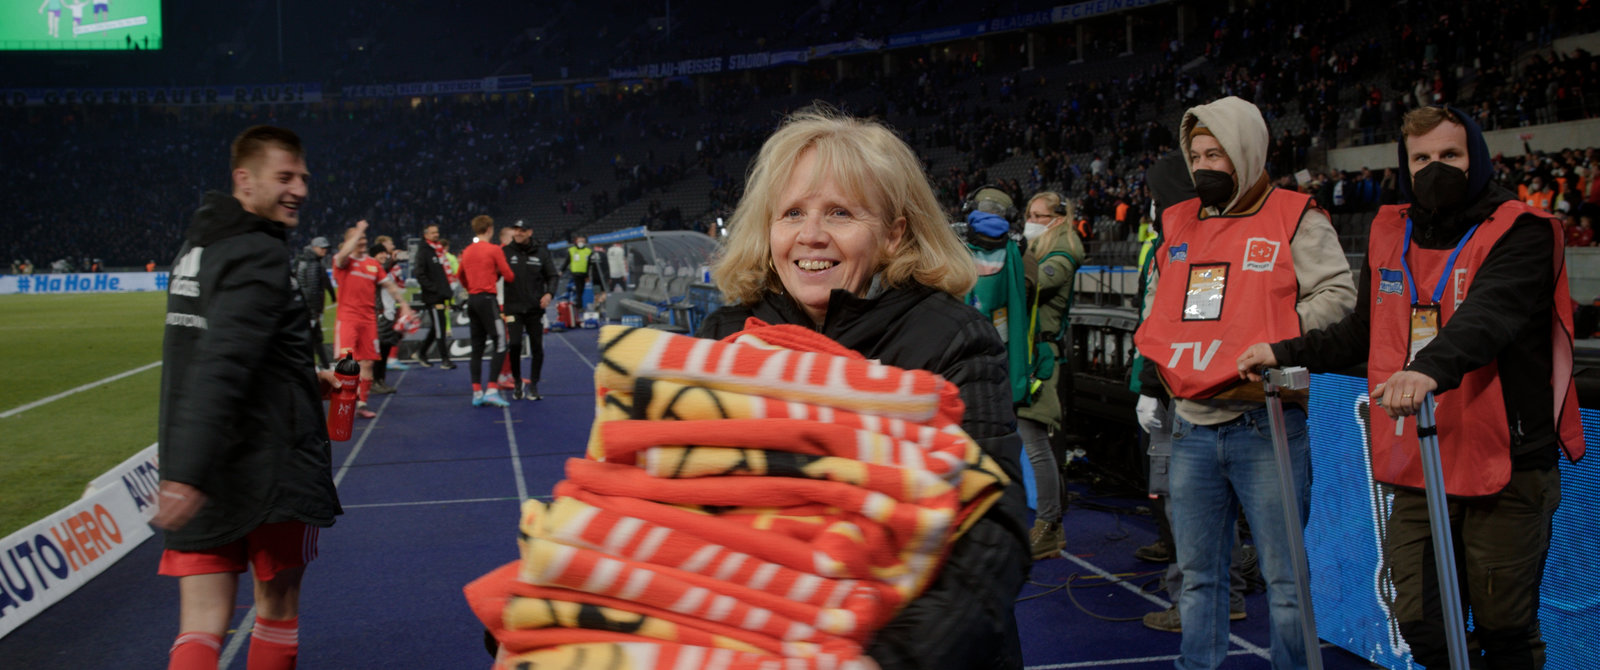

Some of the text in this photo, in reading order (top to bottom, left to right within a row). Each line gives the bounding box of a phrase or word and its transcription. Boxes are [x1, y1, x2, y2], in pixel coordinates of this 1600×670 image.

[44, 88, 218, 106] GEGENBAUER
[235, 84, 304, 103] RAUS!
[1167, 339, 1223, 371] TV
[122, 460, 159, 512] AUTO
